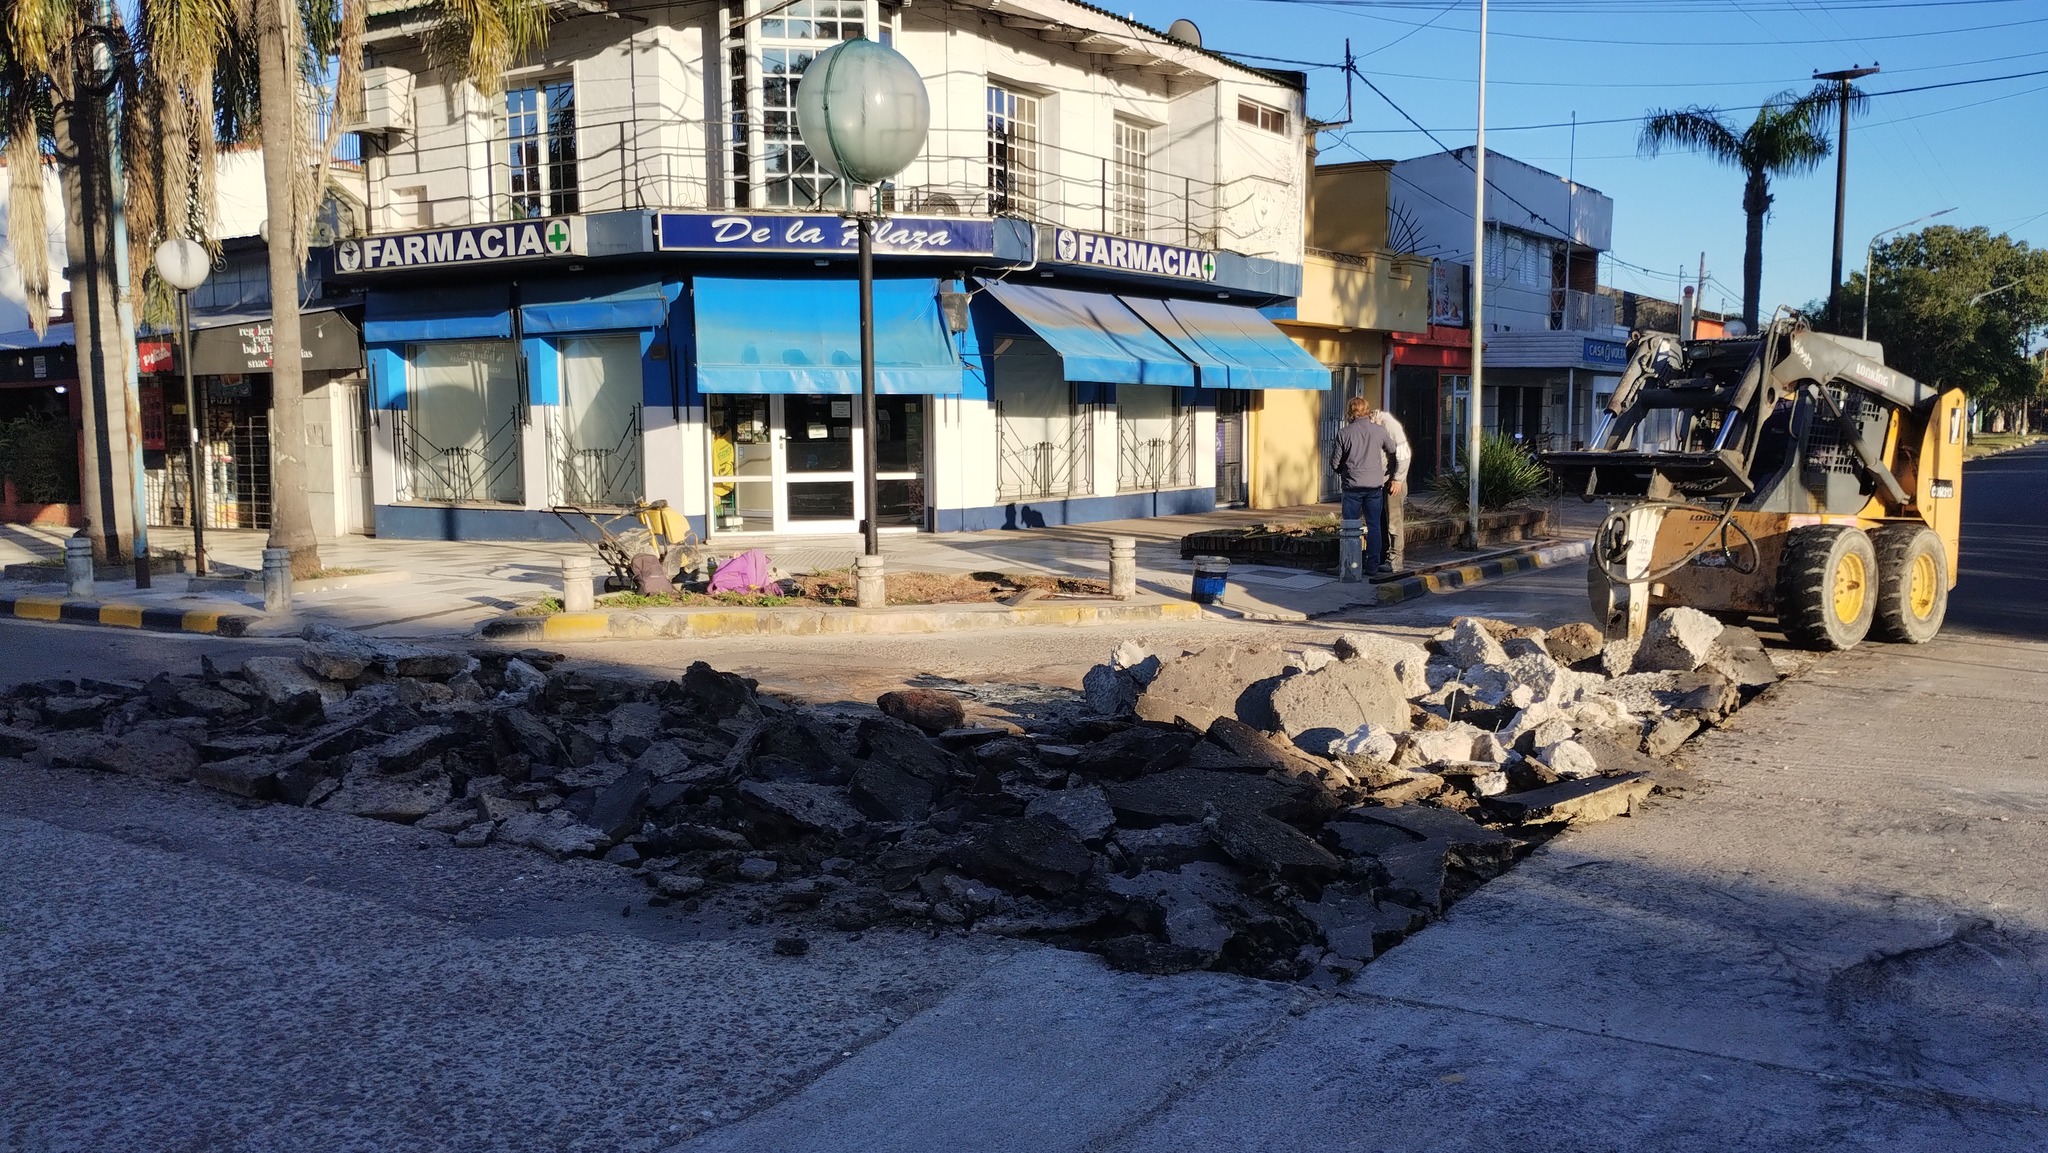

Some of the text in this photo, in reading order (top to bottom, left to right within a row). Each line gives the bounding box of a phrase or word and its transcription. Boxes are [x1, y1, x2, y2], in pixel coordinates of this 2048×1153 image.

[364, 223, 545, 269] FARMACIA
[711, 217, 953, 251] De la Plaza
[1079, 233, 1202, 279] FARMACIA
[1589, 344, 1605, 358] CASA
